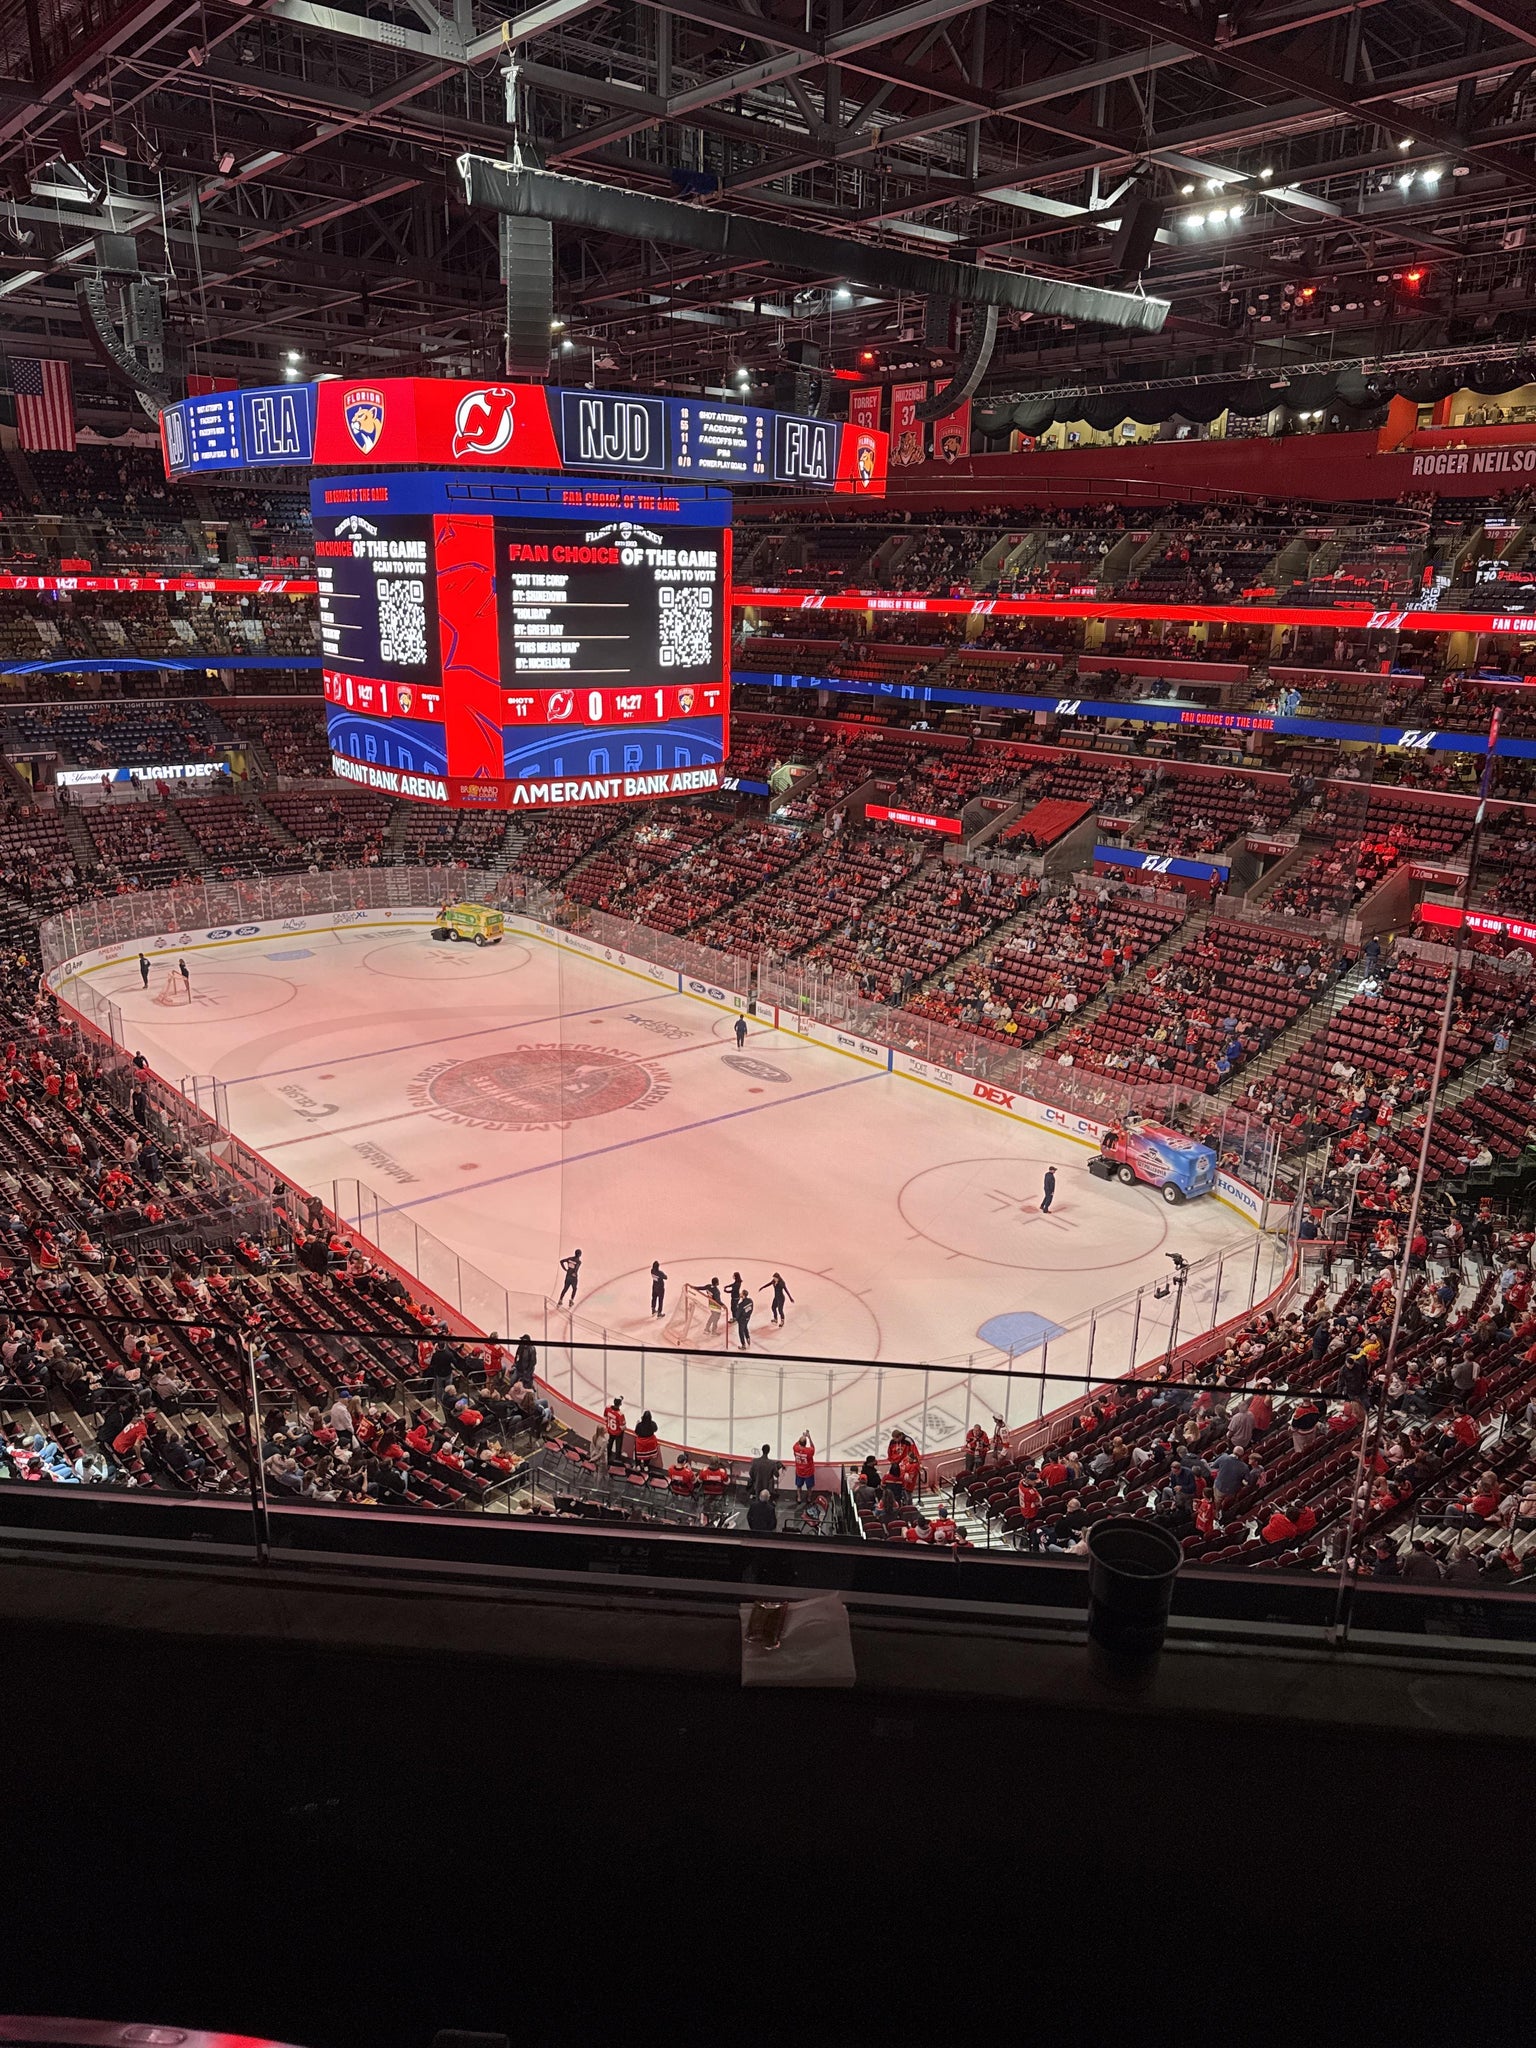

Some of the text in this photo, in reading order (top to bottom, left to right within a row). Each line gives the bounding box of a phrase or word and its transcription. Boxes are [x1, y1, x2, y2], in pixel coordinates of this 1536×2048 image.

[347, 391, 381, 405] FLORIDA
[854, 395, 877, 409] TORREY
[698, 410, 717, 420] SHOT
[717, 413, 748, 424] ATTEMPTS
[902, 405, 916, 426] 37
[251, 395, 300, 455] FLA
[579, 399, 649, 462] NJD
[703, 423, 737, 434] FACEOFF
[681, 432, 748, 447] 11 FACEOFFS WON
[785, 422, 828, 479] FLA
[1412, 450, 1536, 476] ROGER NEILSO
[359, 488, 370, 502] THE
[371, 487, 389, 501] GAME
[562, 491, 583, 506] FAN
[623, 494, 635, 509] OF
[352, 540, 366, 558] OF
[366, 540, 389, 558] THE
[389, 541, 427, 559] GAME
[509, 544, 717, 568] FAN CHOICE OF THE GAME
[372, 561, 427, 575] SCAN TO VOTE
[654, 568, 717, 582] SCAN TO VOTE
[56, 577, 78, 590] 14:27
[113, 578, 119, 590] 1
[903, 600, 912, 609] THE
[912, 600, 927, 610] GAME
[1492, 617, 1511, 630] FAN
[345, 677, 354, 706] 0
[379, 683, 388, 713] 1
[615, 694, 642, 711] 14:27
[654, 689, 663, 718] 1
[515, 704, 528, 717] 11
[588, 691, 603, 721] 0
[623, 711, 634, 719] INT.
[1180, 711, 1274, 730] FAN CHOICE OF THE GAME
[129, 765, 184, 780] FLIGHT
[368, 768, 399, 792] BANK
[400, 775, 449, 801] ARENA
[512, 768, 718, 805] AMERANT BANK ARENA
[1512, 924, 1522, 934] OF
[98, 943, 125, 957] AMERANT
[105, 952, 119, 961] BANK
[757, 1006, 773, 1018] Health
[516, 1043, 641, 1060] AMERANT
[413, 1056, 464, 1084] ARENA
[627, 1060, 673, 1112] BANK ARENA
[277, 1085, 318, 1108] CELSIUS
[406, 1083, 435, 1108] BANK
[973, 1082, 1016, 1110] DEX
[429, 1111, 573, 1133] AMERANT
[1046, 1108, 1065, 1124] CH
[1077, 1120, 1098, 1136] CH
[1217, 1178, 1258, 1213] HONDA
